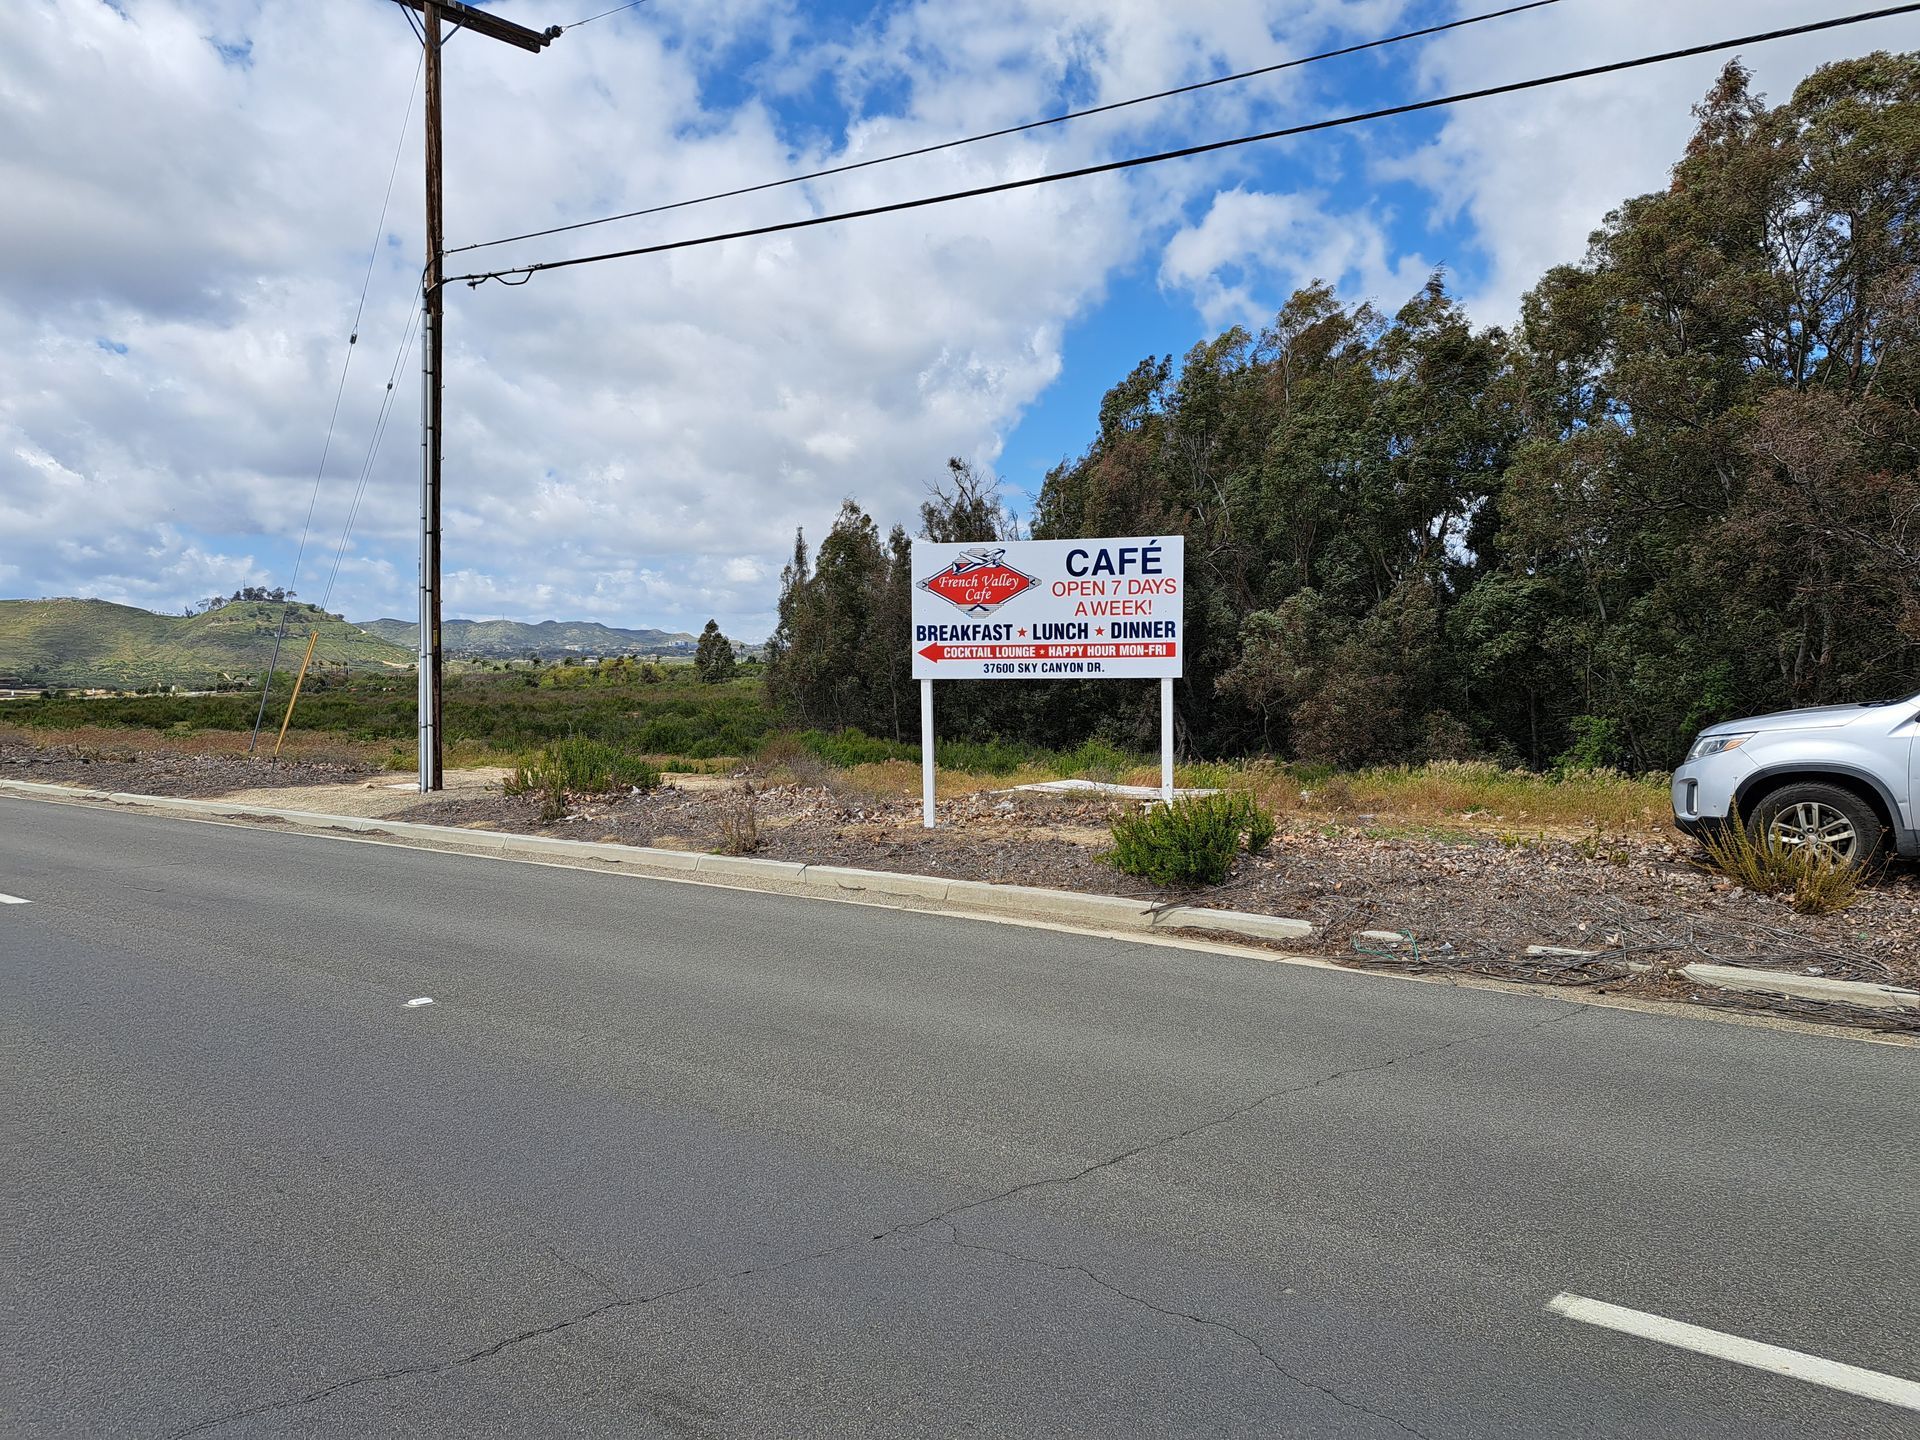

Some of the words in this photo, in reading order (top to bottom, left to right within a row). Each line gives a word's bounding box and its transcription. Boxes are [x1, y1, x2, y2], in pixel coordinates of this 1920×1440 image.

[1066, 539, 1162, 577] CAFÉ
[939, 574, 978, 588] French
[981, 573, 1019, 590] Valley
[1052, 580, 1105, 597] OPEN
[1111, 580, 1121, 595] 7
[1128, 578, 1177, 595] DAYS
[965, 586, 992, 603] Cafe
[1074, 601, 1088, 616] A
[1090, 600, 1152, 616] WEEK!
[916, 624, 1013, 641] BREAKFAST
[1033, 622, 1088, 640] LUNCH
[1111, 621, 1176, 639] DINNER
[944, 647, 993, 658] COCKTAIL
[996, 646, 1035, 657] LOUNGE
[1048, 645, 1084, 656] HAPPY
[1087, 645, 1116, 656] HOUR
[1119, 644, 1166, 656] MON-FRI
[983, 663, 1014, 673] 37600
[1017, 663, 1038, 673] SKY
[1041, 662, 1083, 673] CANYON
[1087, 662, 1105, 672] DR.
